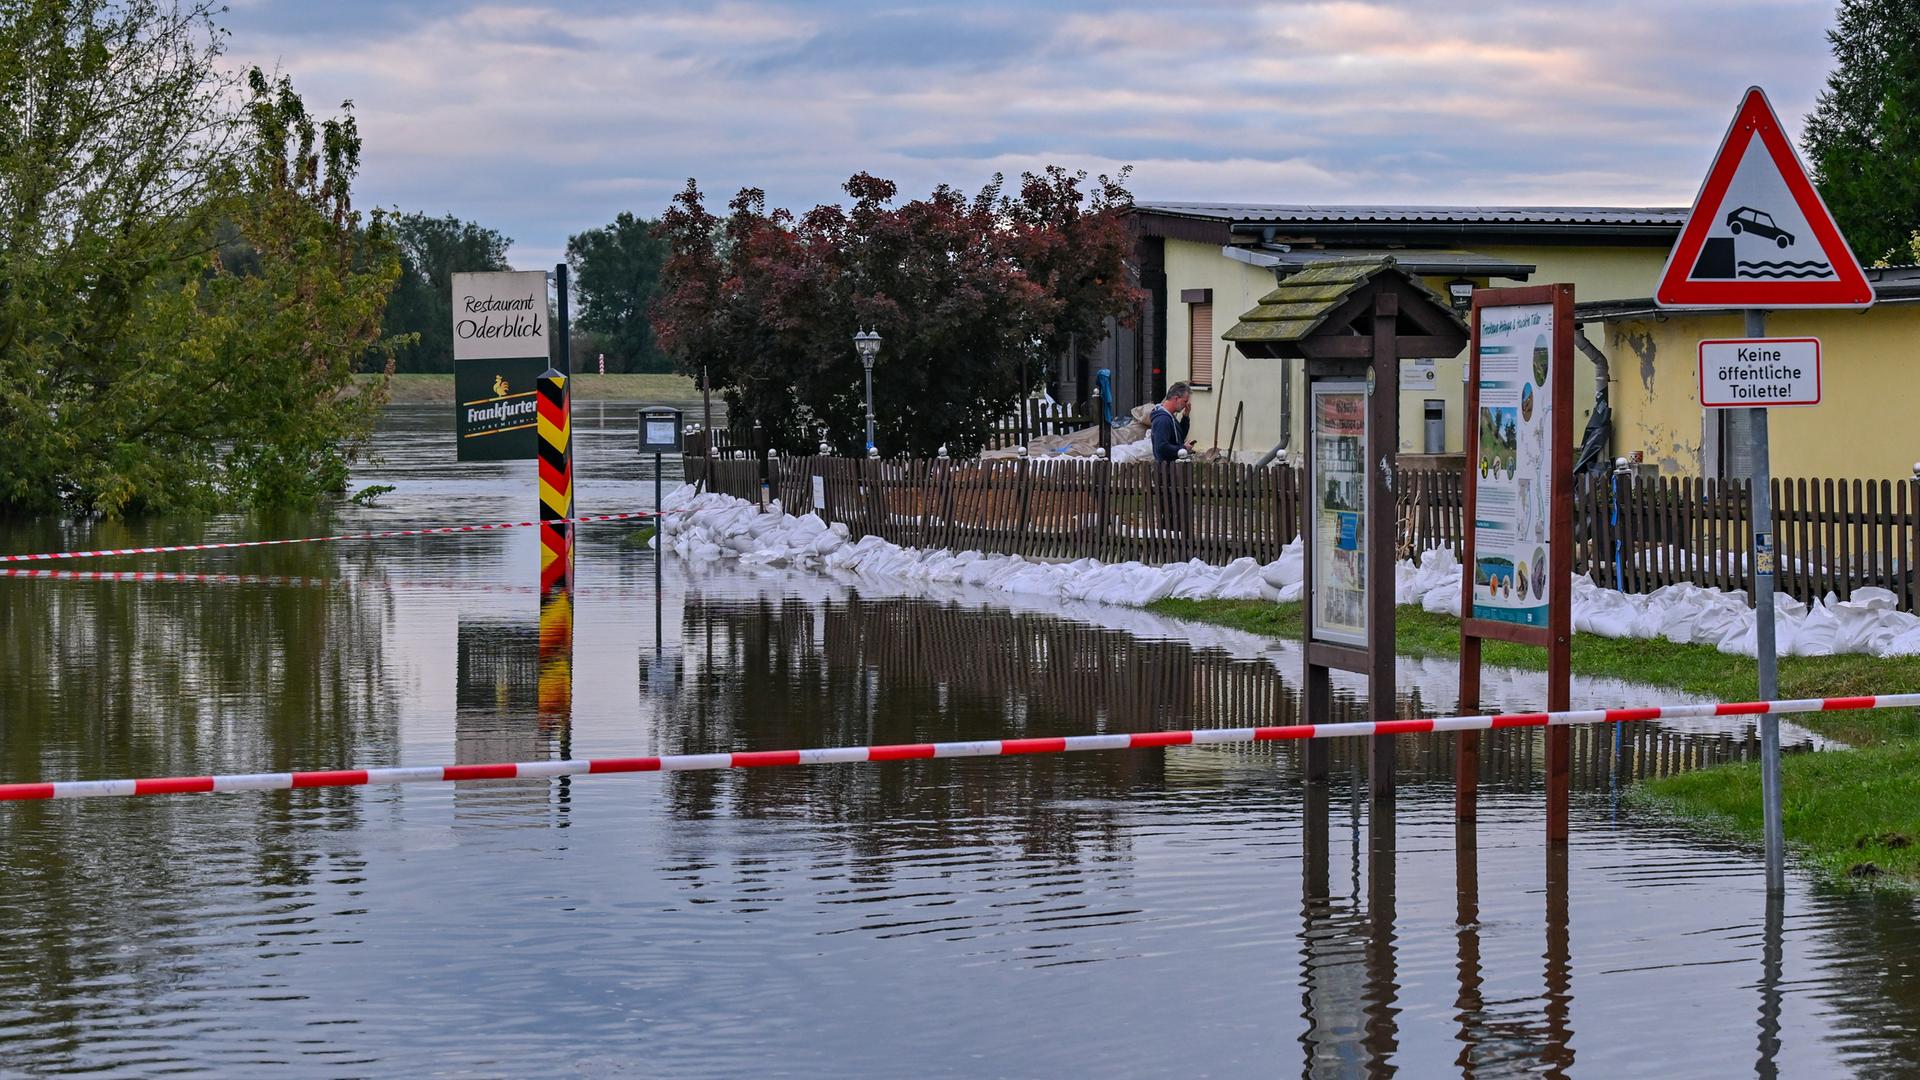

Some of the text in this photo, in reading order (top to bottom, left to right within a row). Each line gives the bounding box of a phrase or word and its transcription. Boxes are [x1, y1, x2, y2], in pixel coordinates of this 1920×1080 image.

[464, 293, 535, 313] Restaurant
[456, 313, 543, 339] Oderblick
[1738, 348, 1781, 362] Keine
[1718, 365, 1801, 380] öffentliche
[1729, 383, 1792, 398] Toilette!
[467, 400, 538, 423] Frankfurter
